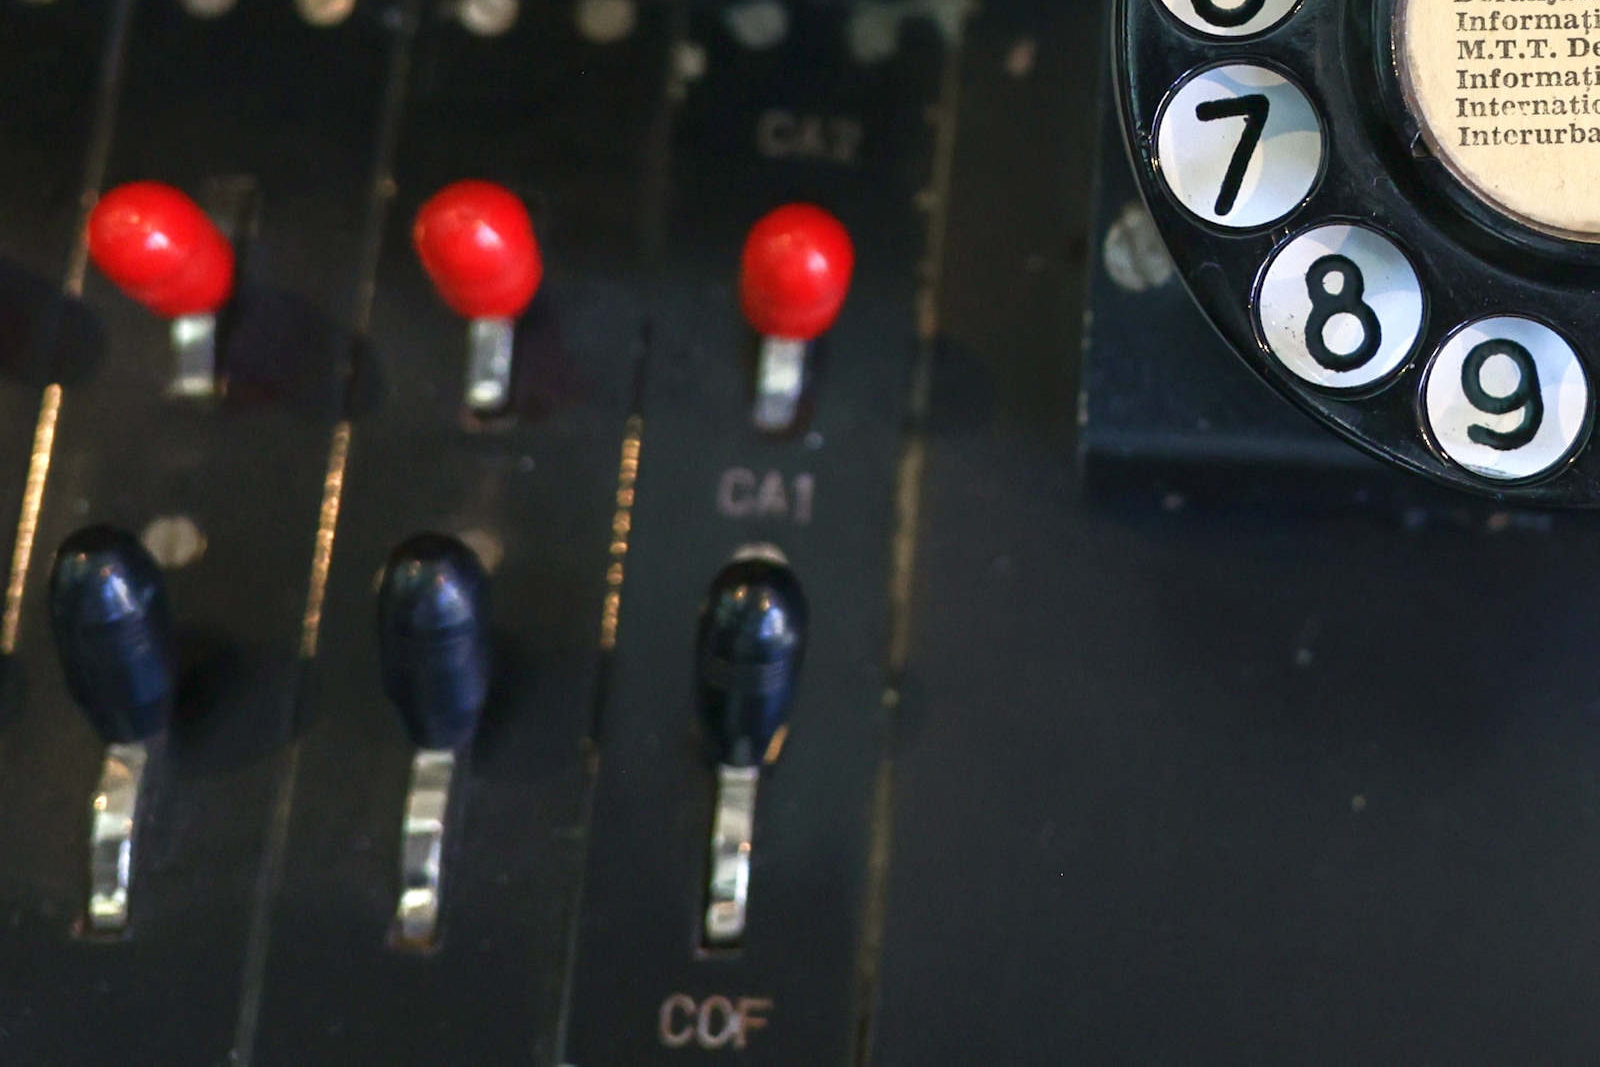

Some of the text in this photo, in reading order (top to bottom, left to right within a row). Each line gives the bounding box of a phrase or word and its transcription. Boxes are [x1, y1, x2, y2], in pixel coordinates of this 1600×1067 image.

[1456, 38, 1557, 60] M.T.T.
[1195, 93, 1270, 217] 7
[1303, 253, 1382, 373] 8
[1460, 338, 1544, 451] 9
